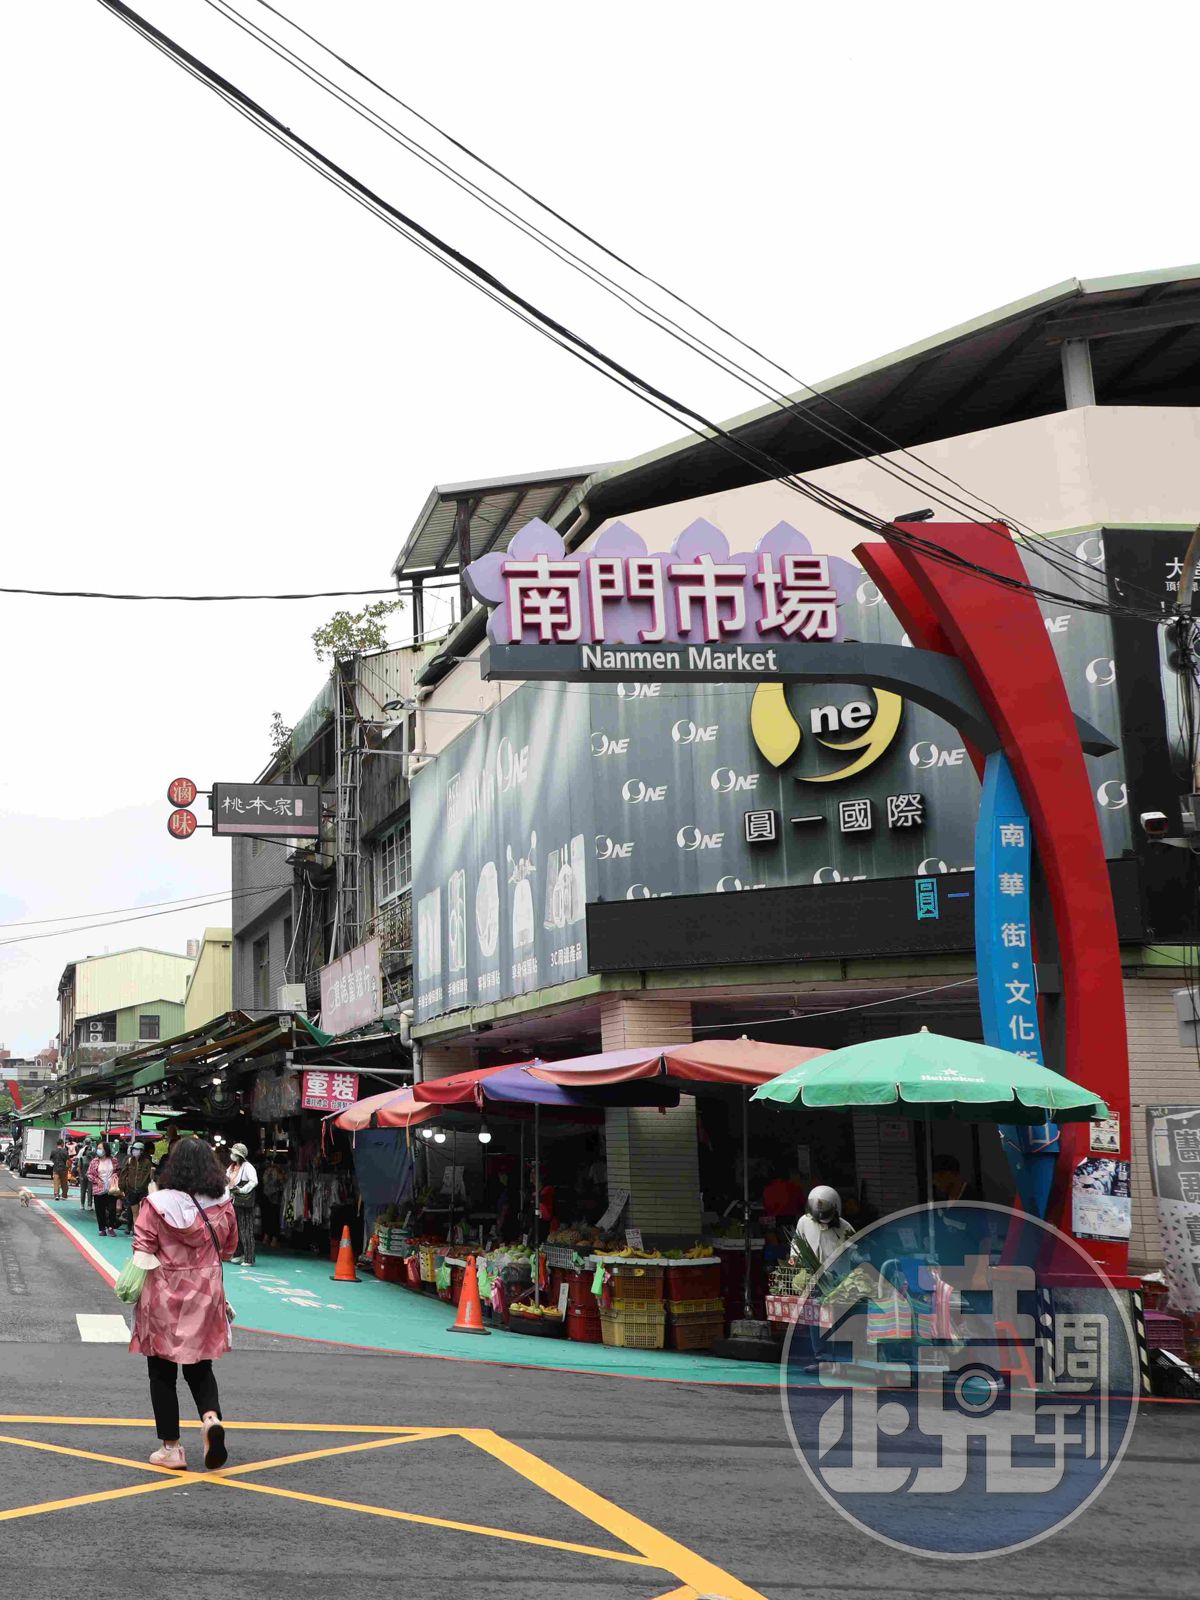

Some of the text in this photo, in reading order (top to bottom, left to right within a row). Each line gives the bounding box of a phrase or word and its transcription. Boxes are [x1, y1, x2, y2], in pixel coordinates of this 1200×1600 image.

[502, 552, 839, 643] 南門市場
[1044, 614, 1072, 633] NE
[581, 645, 778, 672] Nanmen Market
[591, 731, 630, 756] ONE
[672, 719, 719, 745] ONE
[497, 736, 529, 793] ONE
[909, 741, 966, 769] ONE
[622, 778, 667, 804] ONE
[711, 767, 760, 793] ONE
[220, 796, 293, 816] 桃本家
[744, 793, 923, 842] 圓一國際
[595, 834, 635, 860] ONE
[677, 825, 725, 851] ONE
[305, 1071, 355, 1100] 童裝
